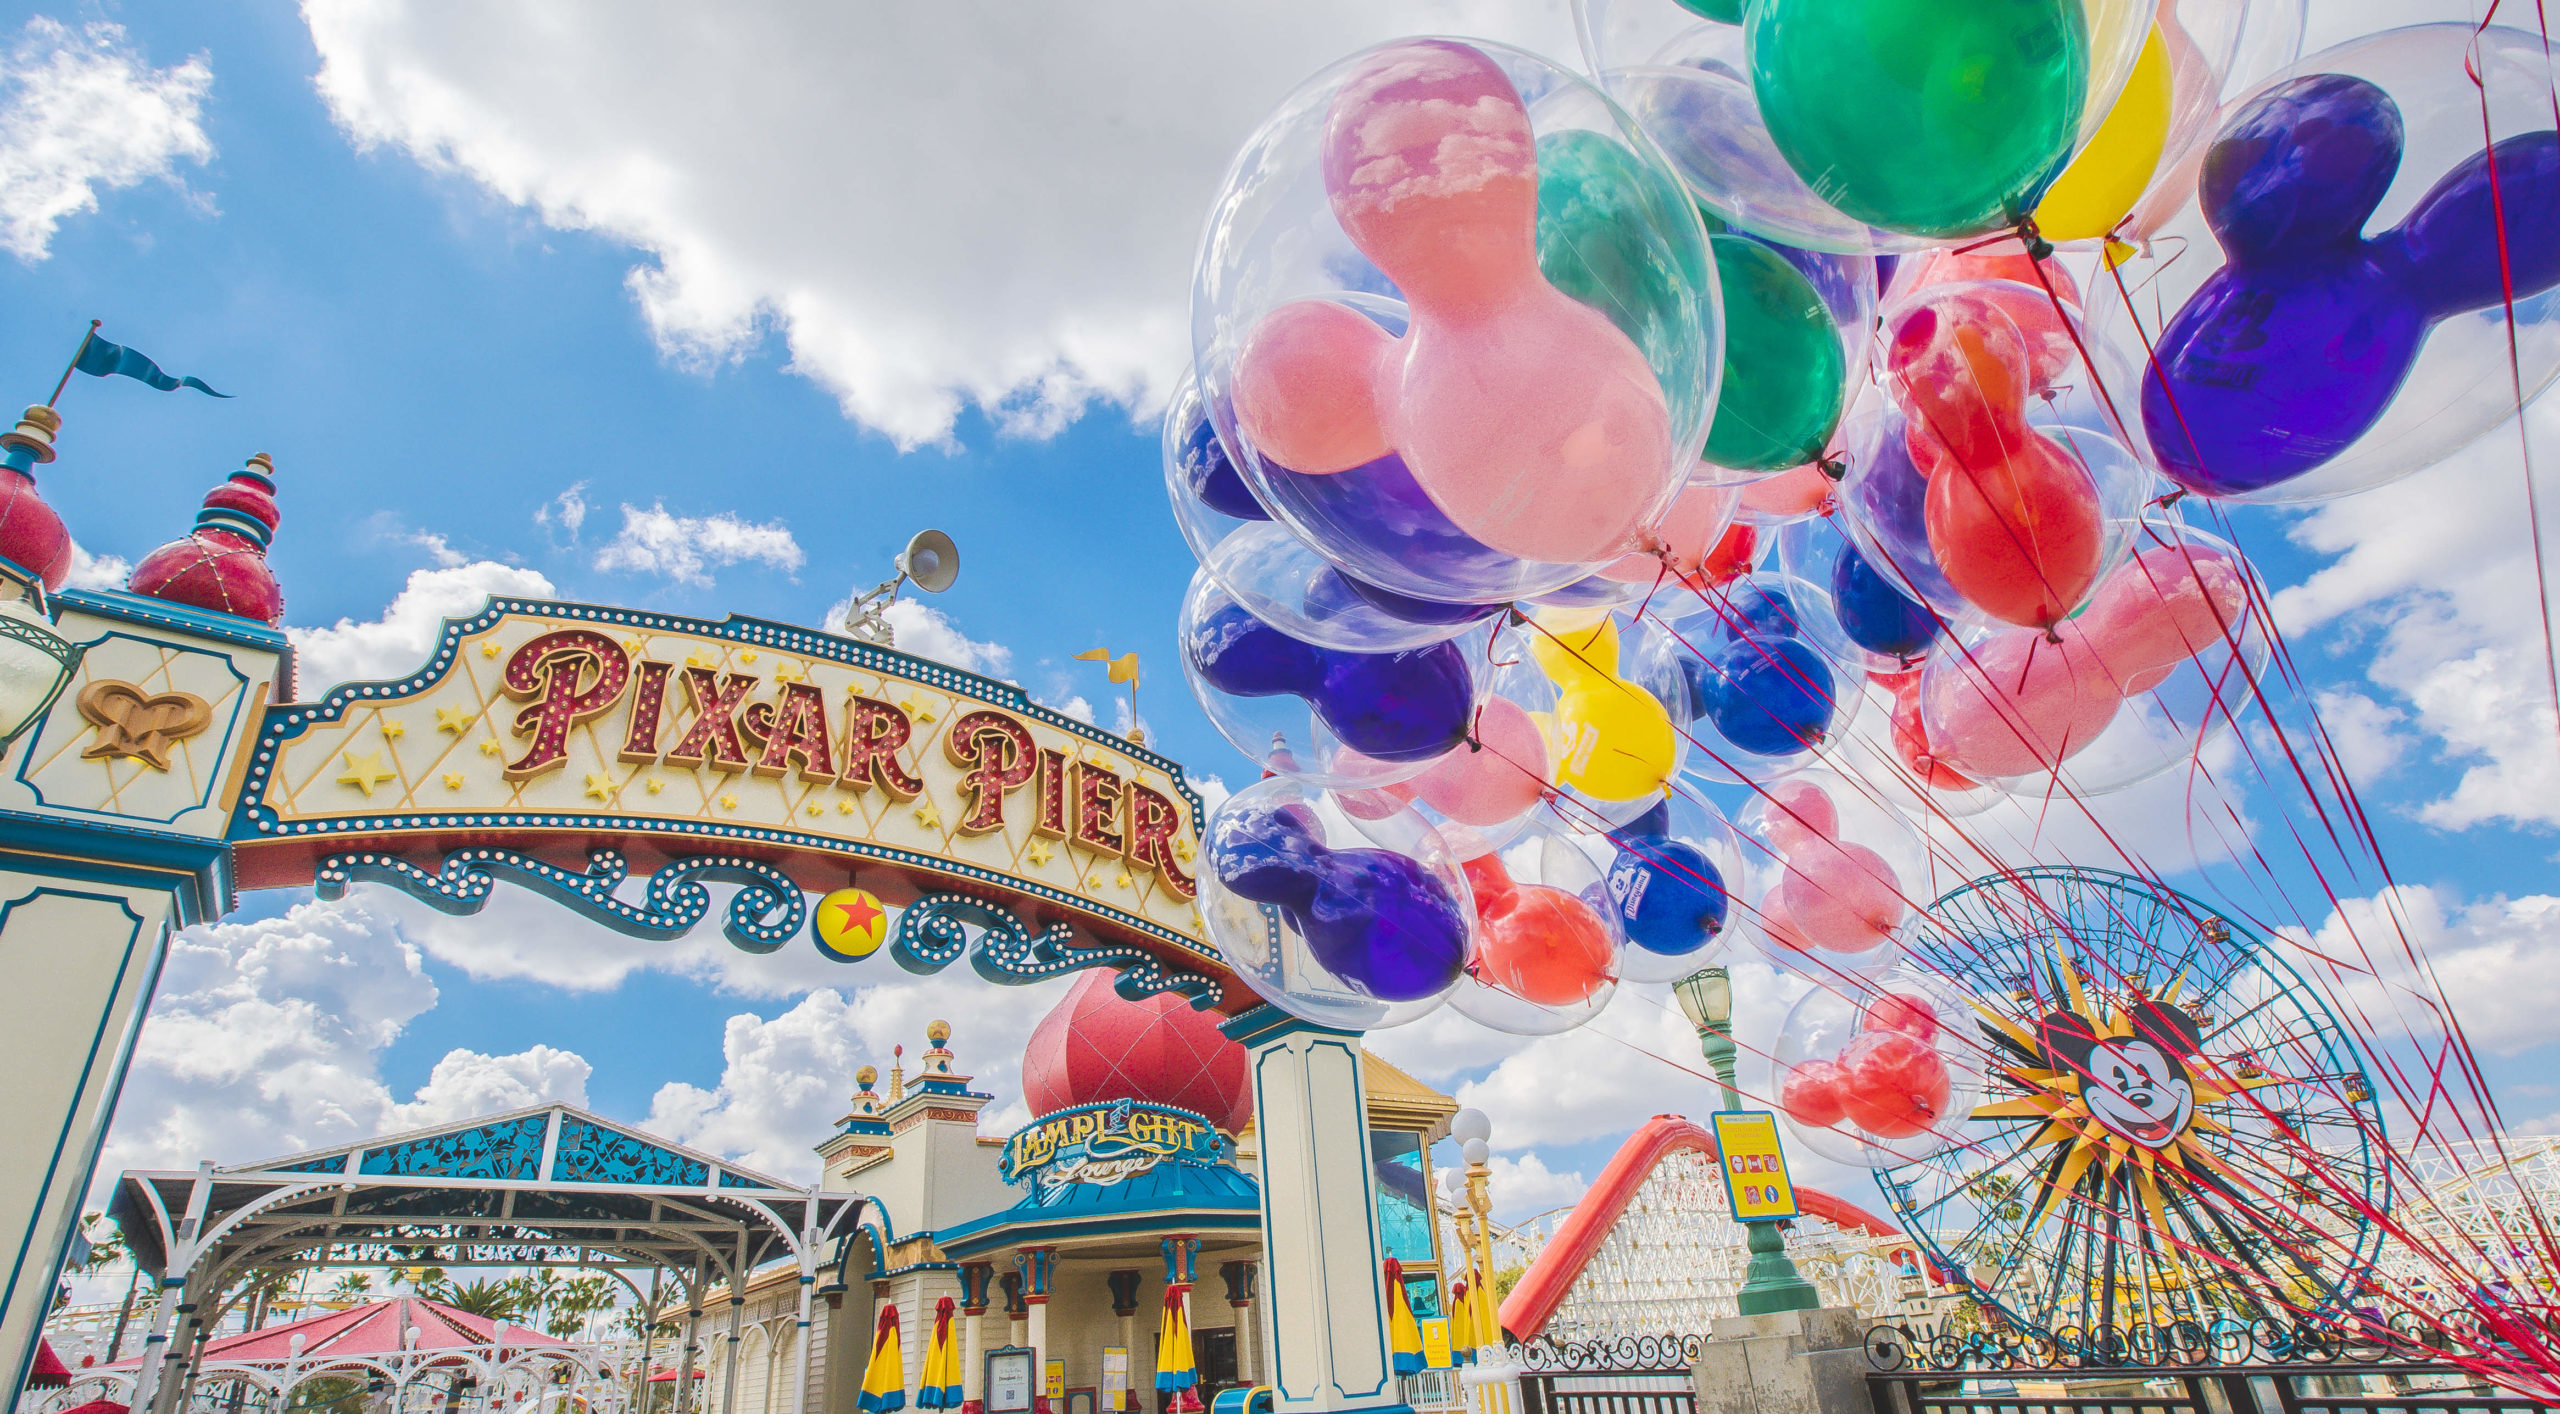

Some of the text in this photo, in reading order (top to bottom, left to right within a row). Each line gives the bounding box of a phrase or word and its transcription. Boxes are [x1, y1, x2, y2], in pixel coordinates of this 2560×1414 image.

[502, 629, 1197, 903] PIXAR PIER
[1626, 874, 1647, 914] Disneyland
[1043, 1147, 1163, 1187] Lounge
